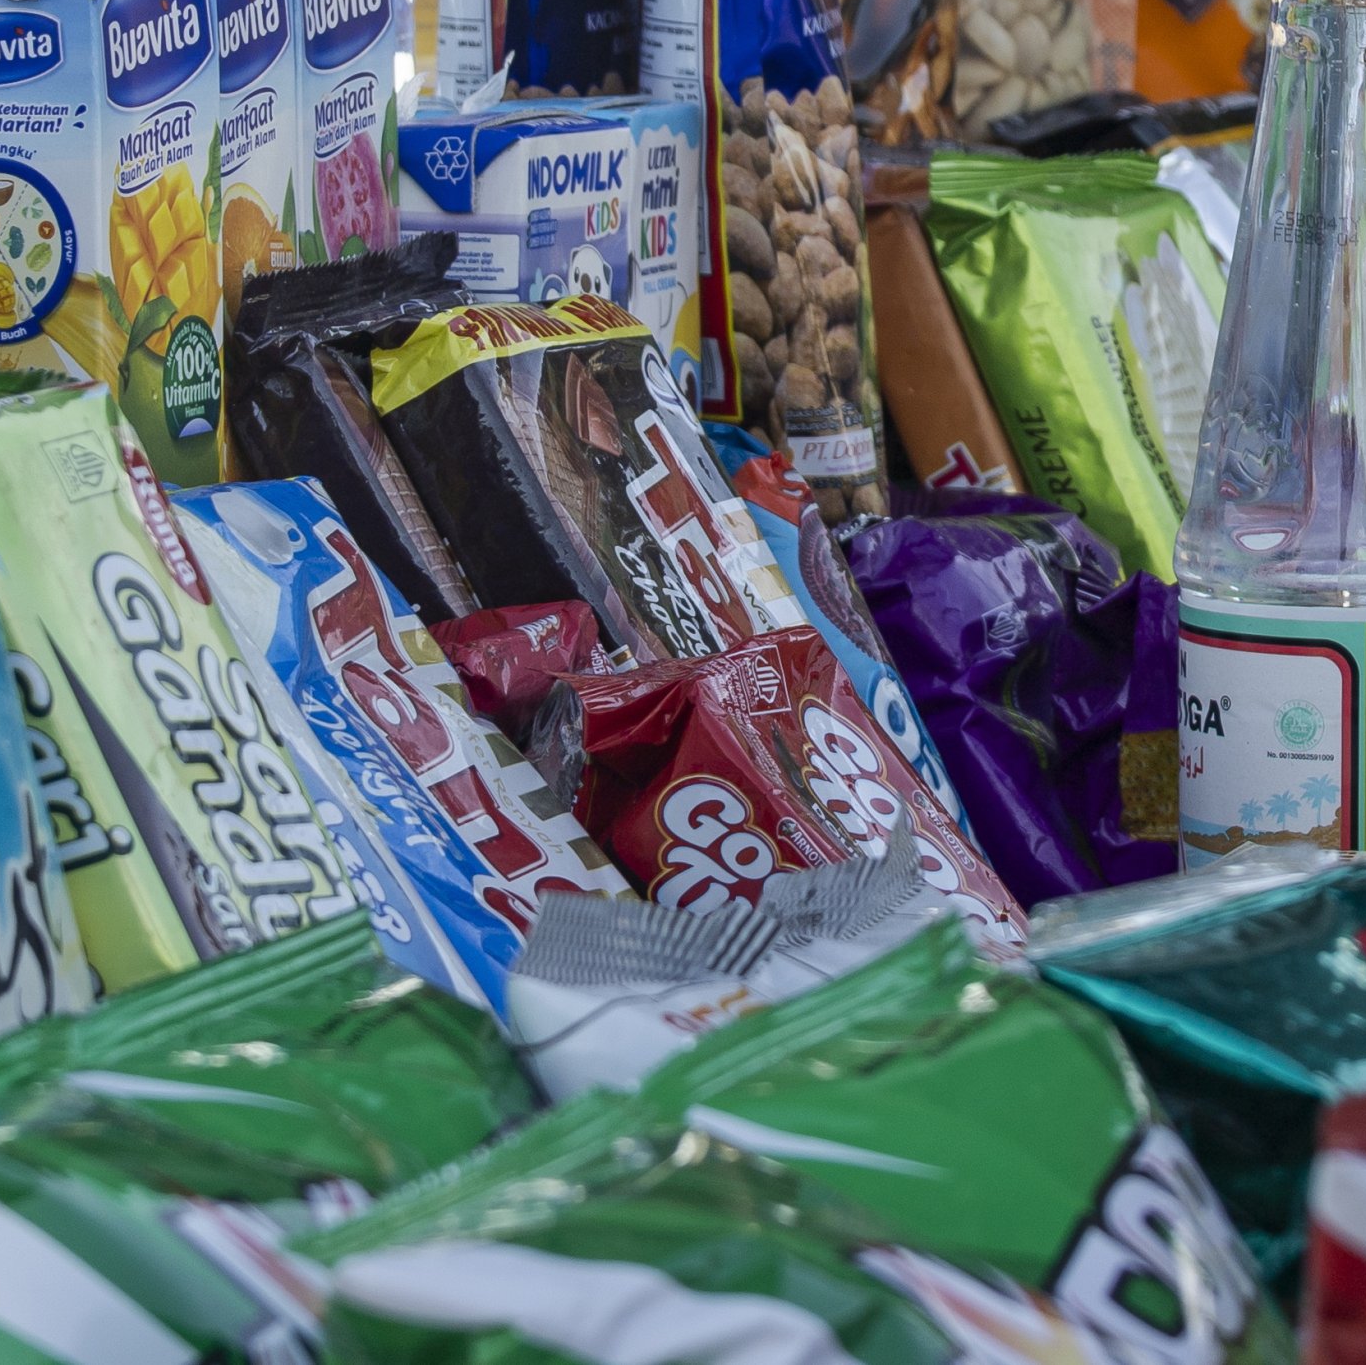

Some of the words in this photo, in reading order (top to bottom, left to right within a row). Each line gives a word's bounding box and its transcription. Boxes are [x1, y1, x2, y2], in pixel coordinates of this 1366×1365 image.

[314, 84, 375, 132] Manfaat
[119, 109, 192, 167] Manfaat
[235, 141, 252, 159] dari
[254, 127, 276, 147] Alam
[316, 135, 334, 152] Buah
[335, 123, 353, 141] dari
[353, 112, 377, 132] Alam
[120, 166, 142, 187] Buah
[143, 154, 164, 173] dari
[166, 143, 193, 164] Alam
[528, 149, 624, 200] INDOMILK
[641, 168, 681, 214] mimi
[64, 230, 74, 264] Sayur
[640, 212, 678, 261] KIDS
[0, 327, 27, 341] Buah
[175, 342, 216, 382] 100%
[802, 441, 829, 460] PT.
[92, 550, 314, 941] Gandu
[1266, 751, 1278, 760] No.
[291, 684, 453, 869] Delight
[436, 693, 492, 770] Wafer
[493, 777, 563, 855] Renyah
